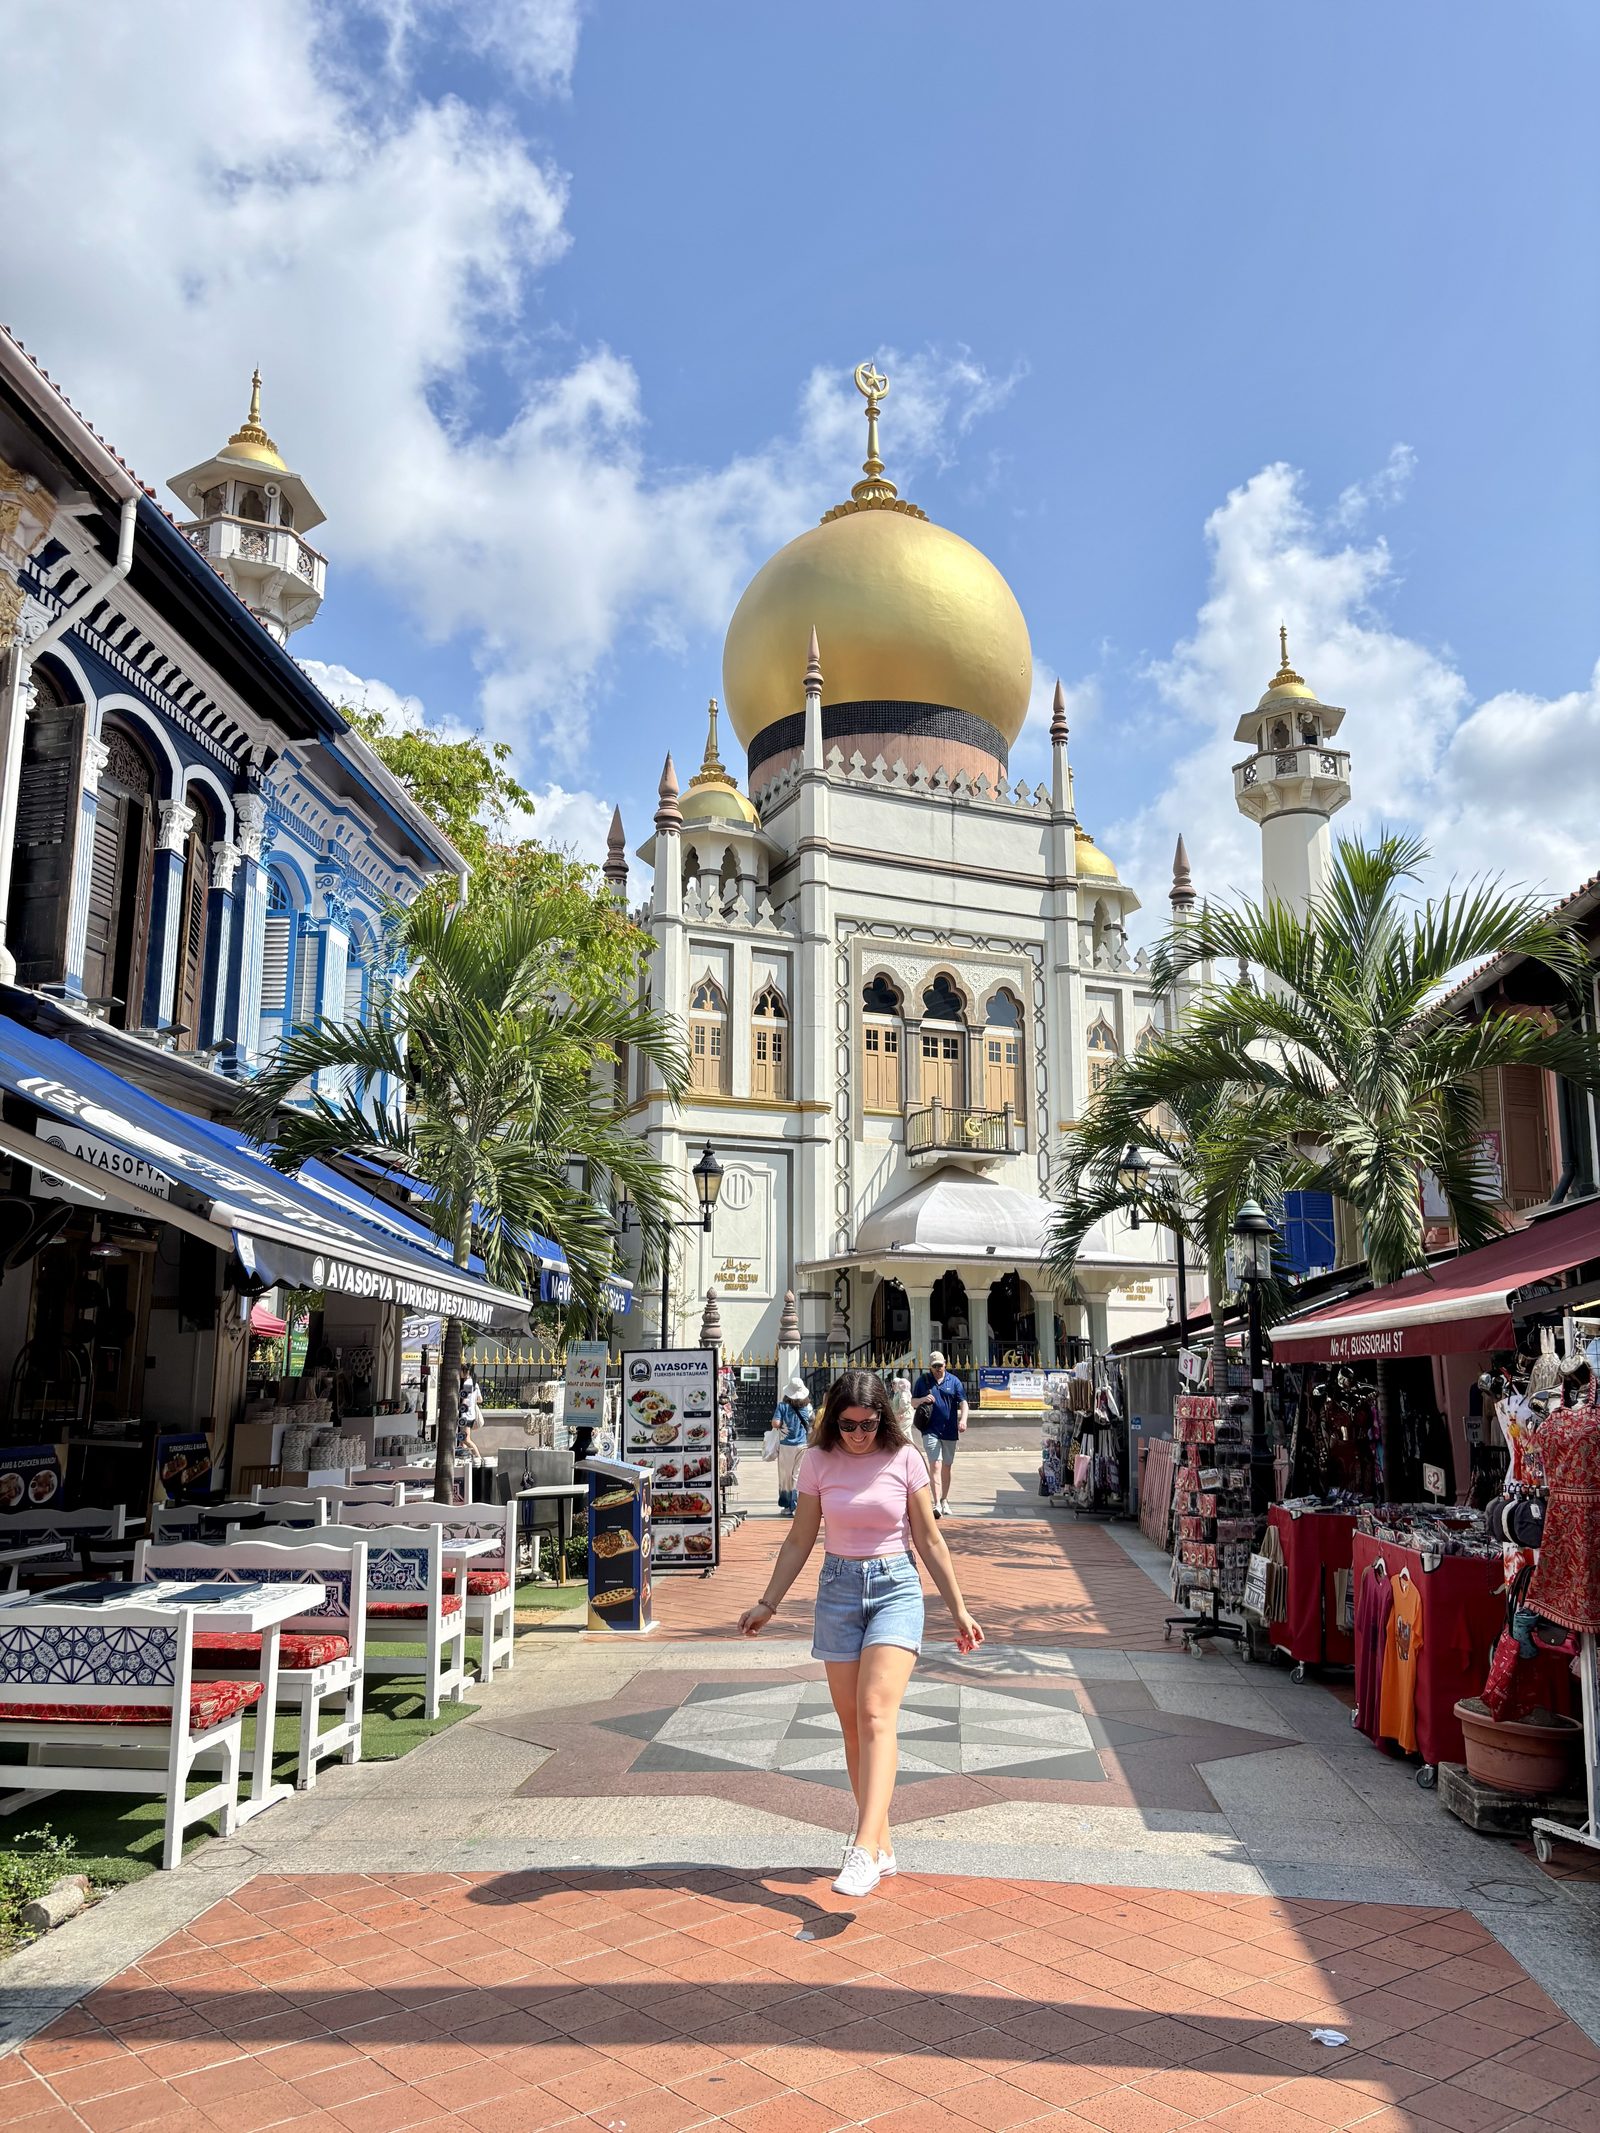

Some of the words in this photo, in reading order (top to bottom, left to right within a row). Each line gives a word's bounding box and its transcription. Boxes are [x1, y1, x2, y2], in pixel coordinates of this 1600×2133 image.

[74, 1144, 166, 1183] AYASOFYA
[327, 1262, 393, 1301] AYASOFYA
[394, 1280, 440, 1313] TURKISH
[439, 1291, 494, 1325] RESTAURANT
[1351, 1332, 1391, 1356] BUSSORAH
[1393, 1331, 1404, 1353] ST
[654, 1362, 708, 1372] AYASOFYA
[17, 1458, 40, 1468] CHICKEN
[1427, 1472, 1439, 1491] $2
